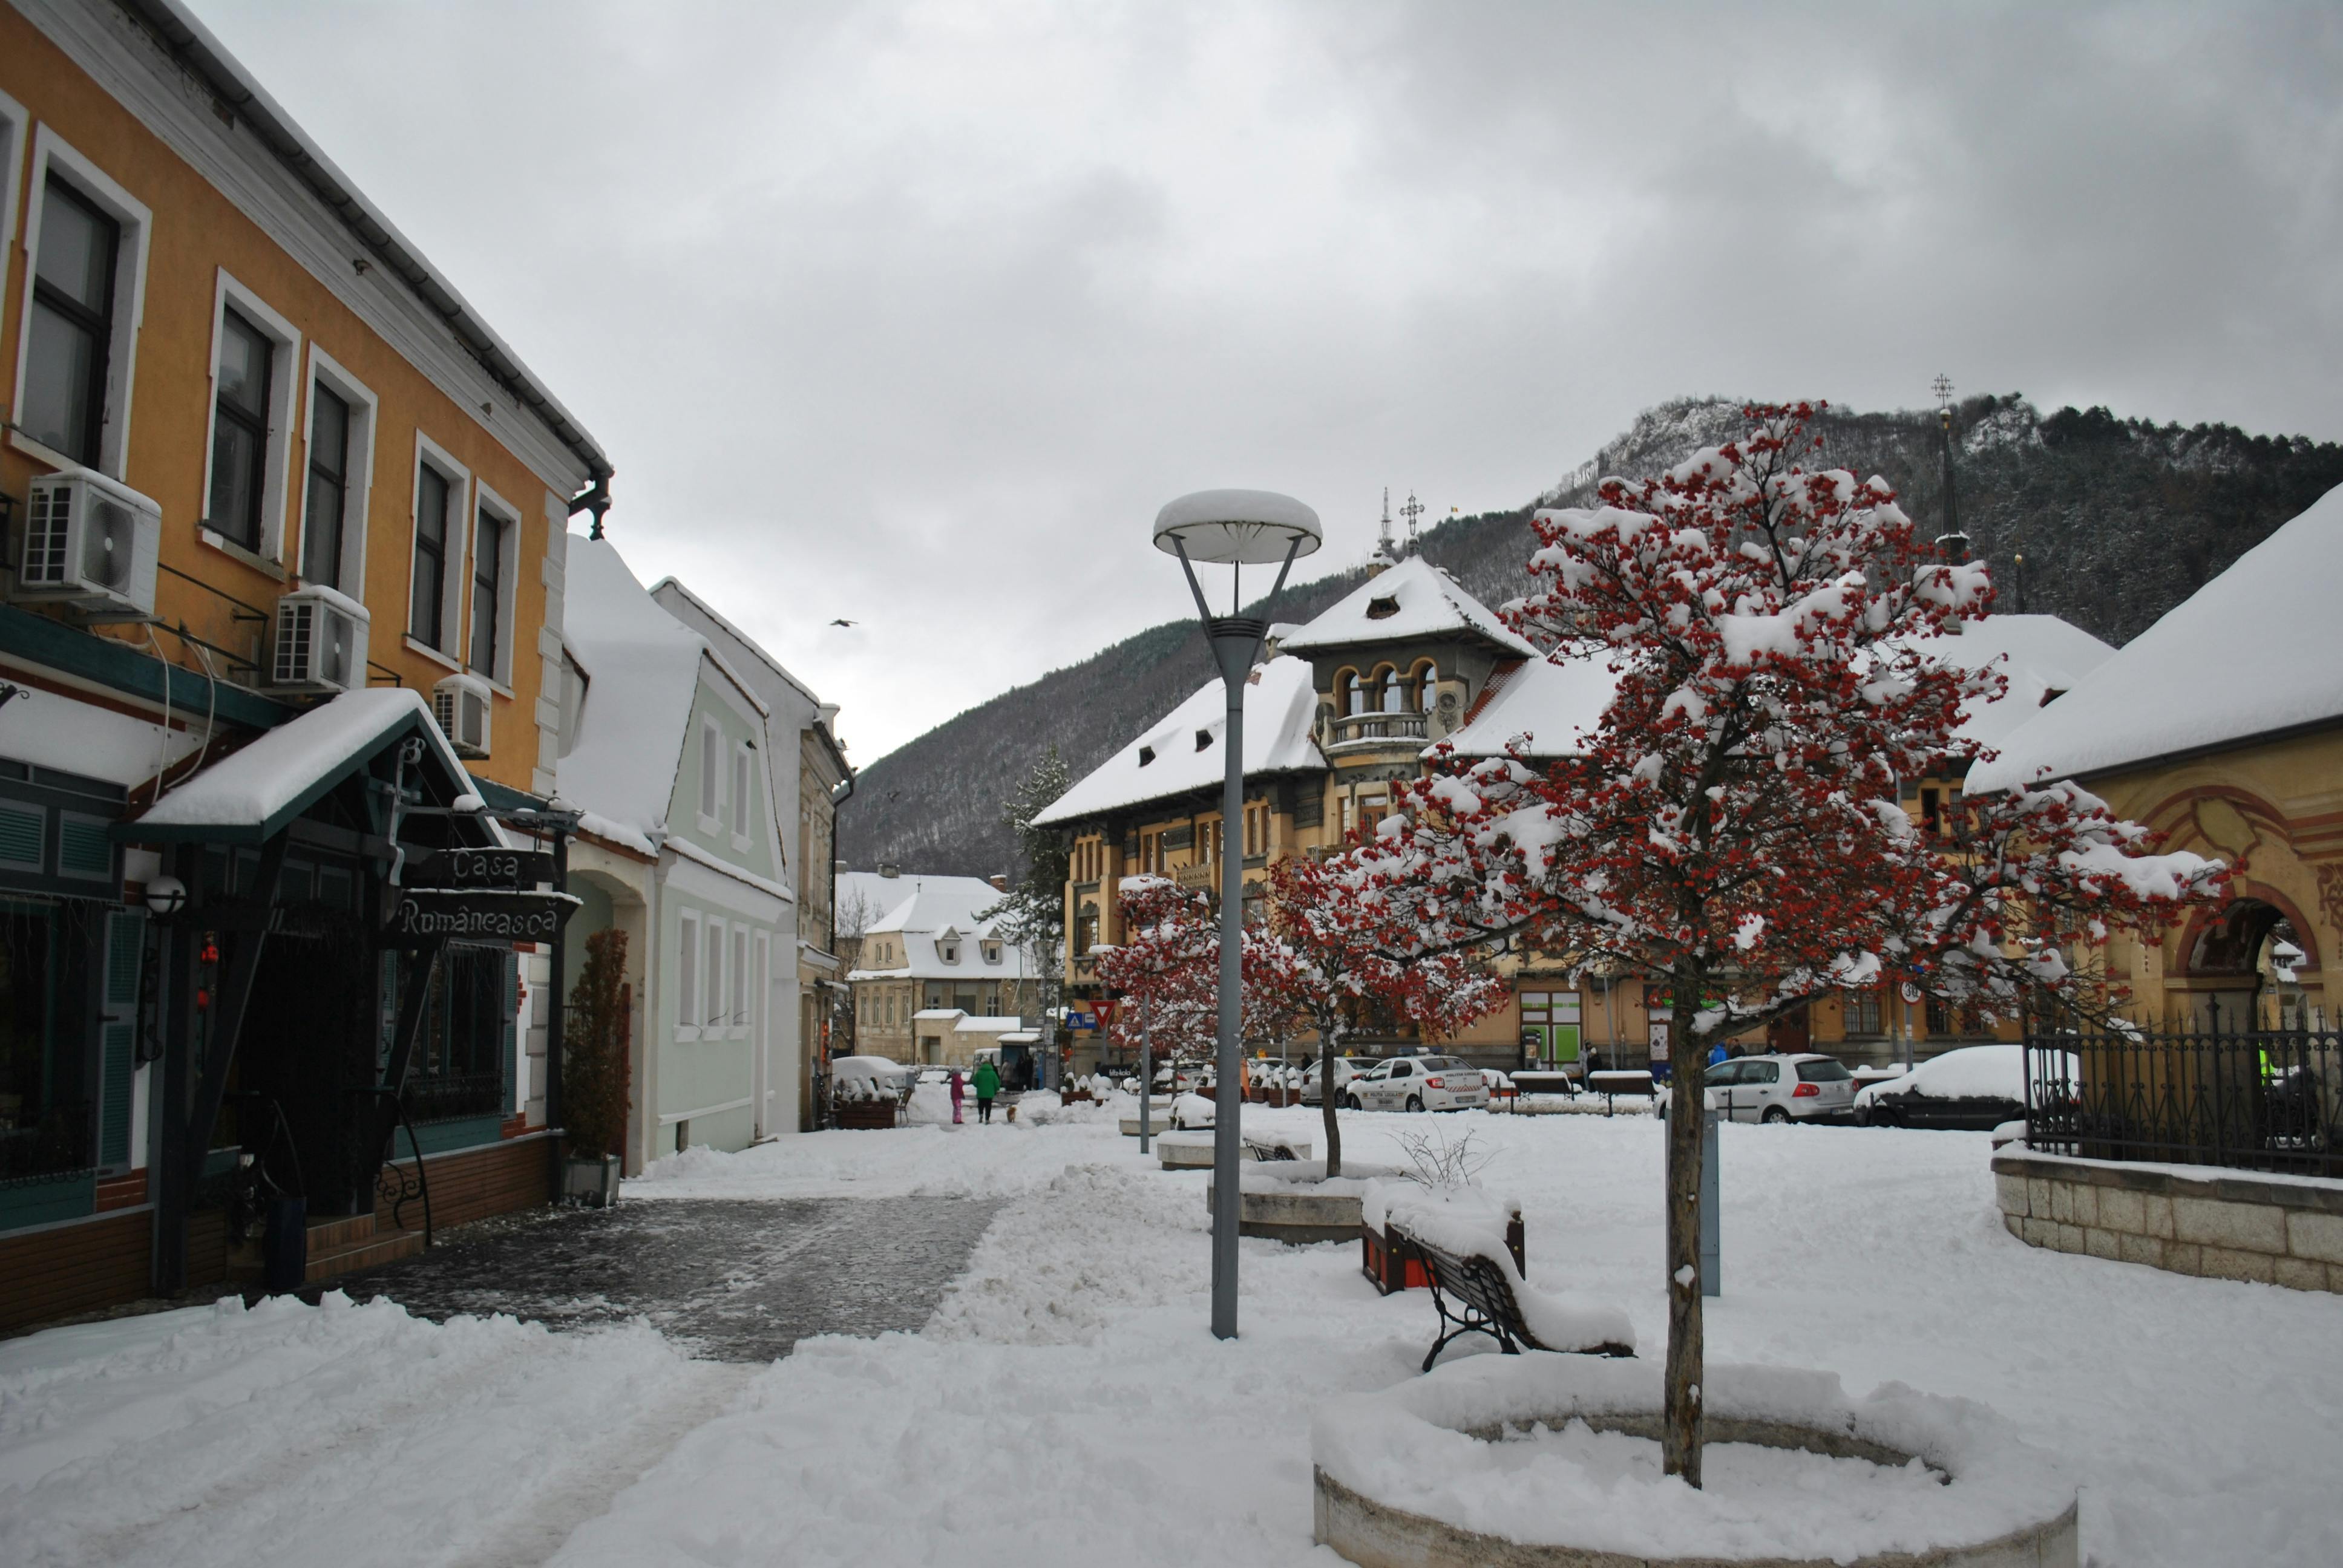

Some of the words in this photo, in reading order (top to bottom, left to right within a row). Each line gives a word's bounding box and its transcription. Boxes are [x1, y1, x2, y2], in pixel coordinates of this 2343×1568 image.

[454, 849, 519, 877] Casa
[398, 897, 557, 935] Românească
[1906, 983, 1918, 997] 30
